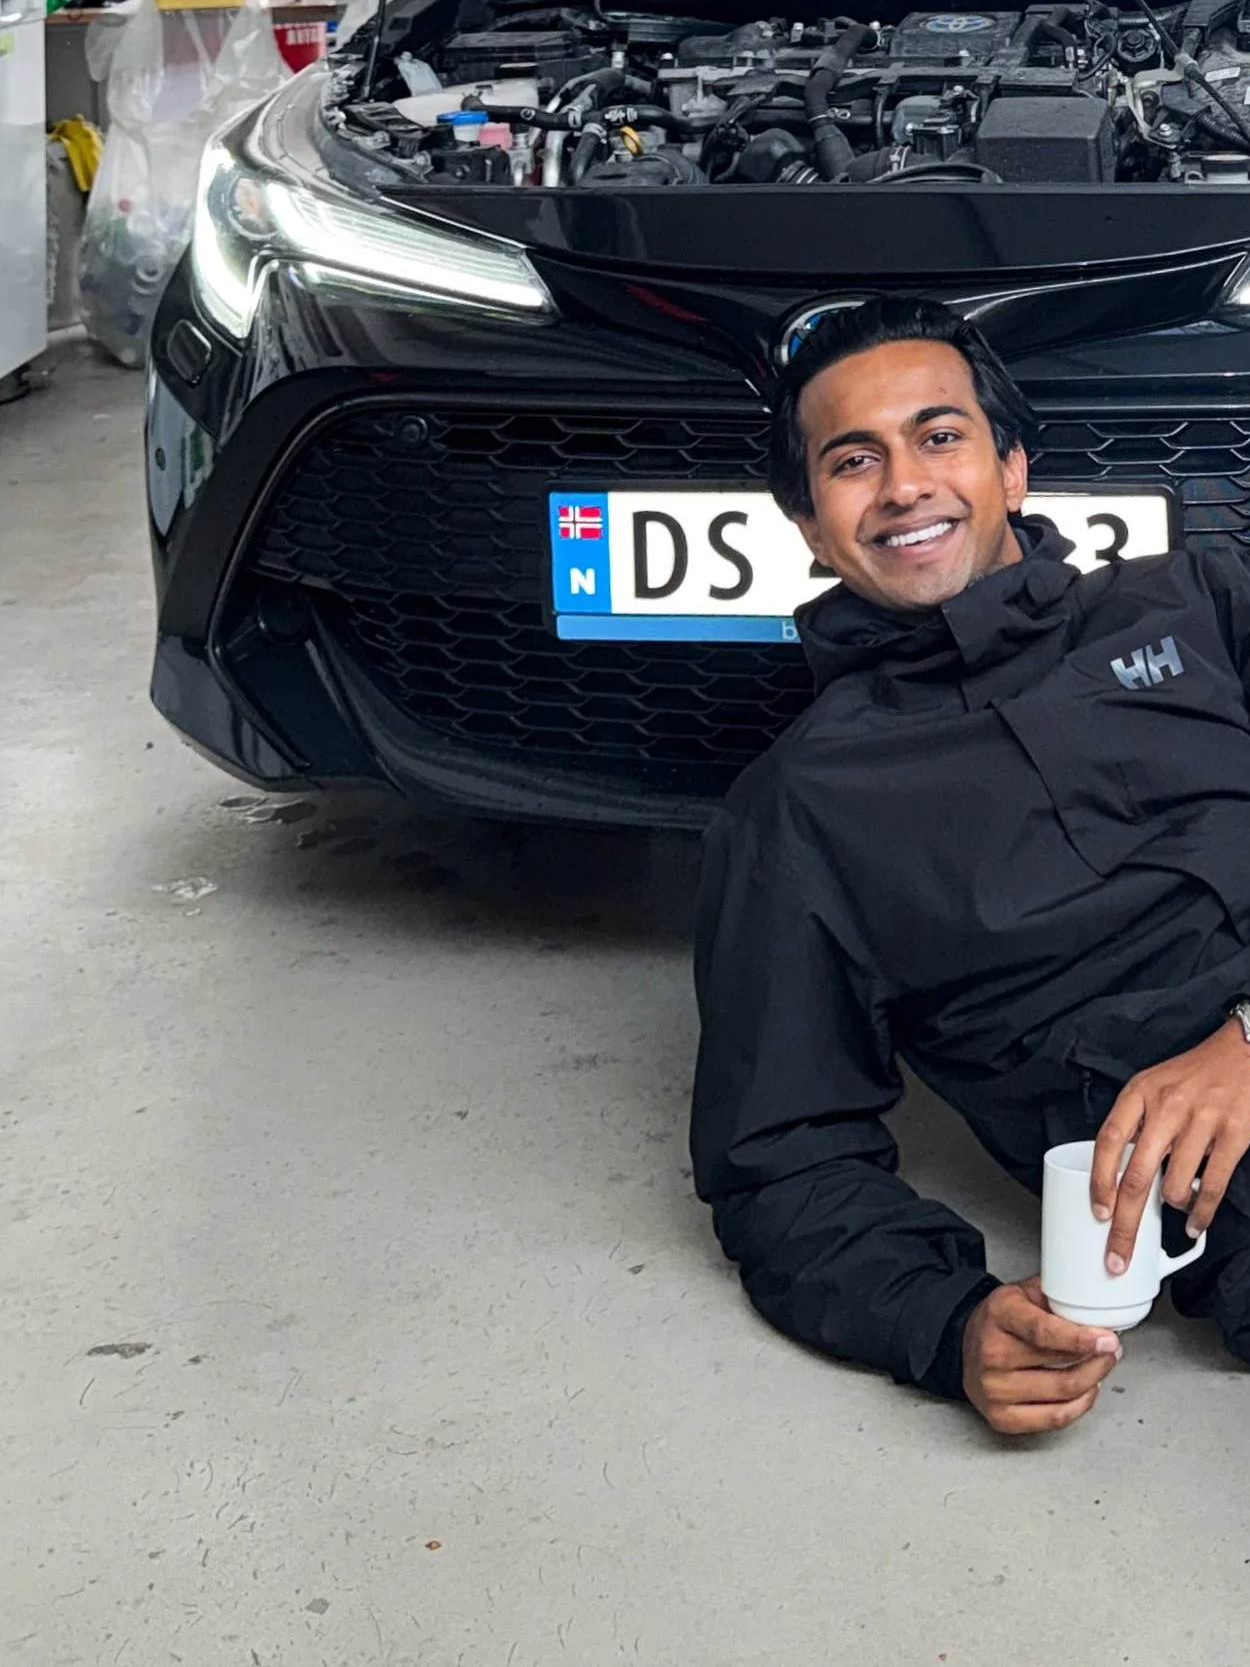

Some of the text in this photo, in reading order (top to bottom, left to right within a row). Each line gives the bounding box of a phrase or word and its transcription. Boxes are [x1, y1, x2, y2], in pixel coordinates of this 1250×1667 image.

[570, 567, 596, 595] N
[632, 510, 754, 601] DS
[1109, 635, 1184, 690] HH
